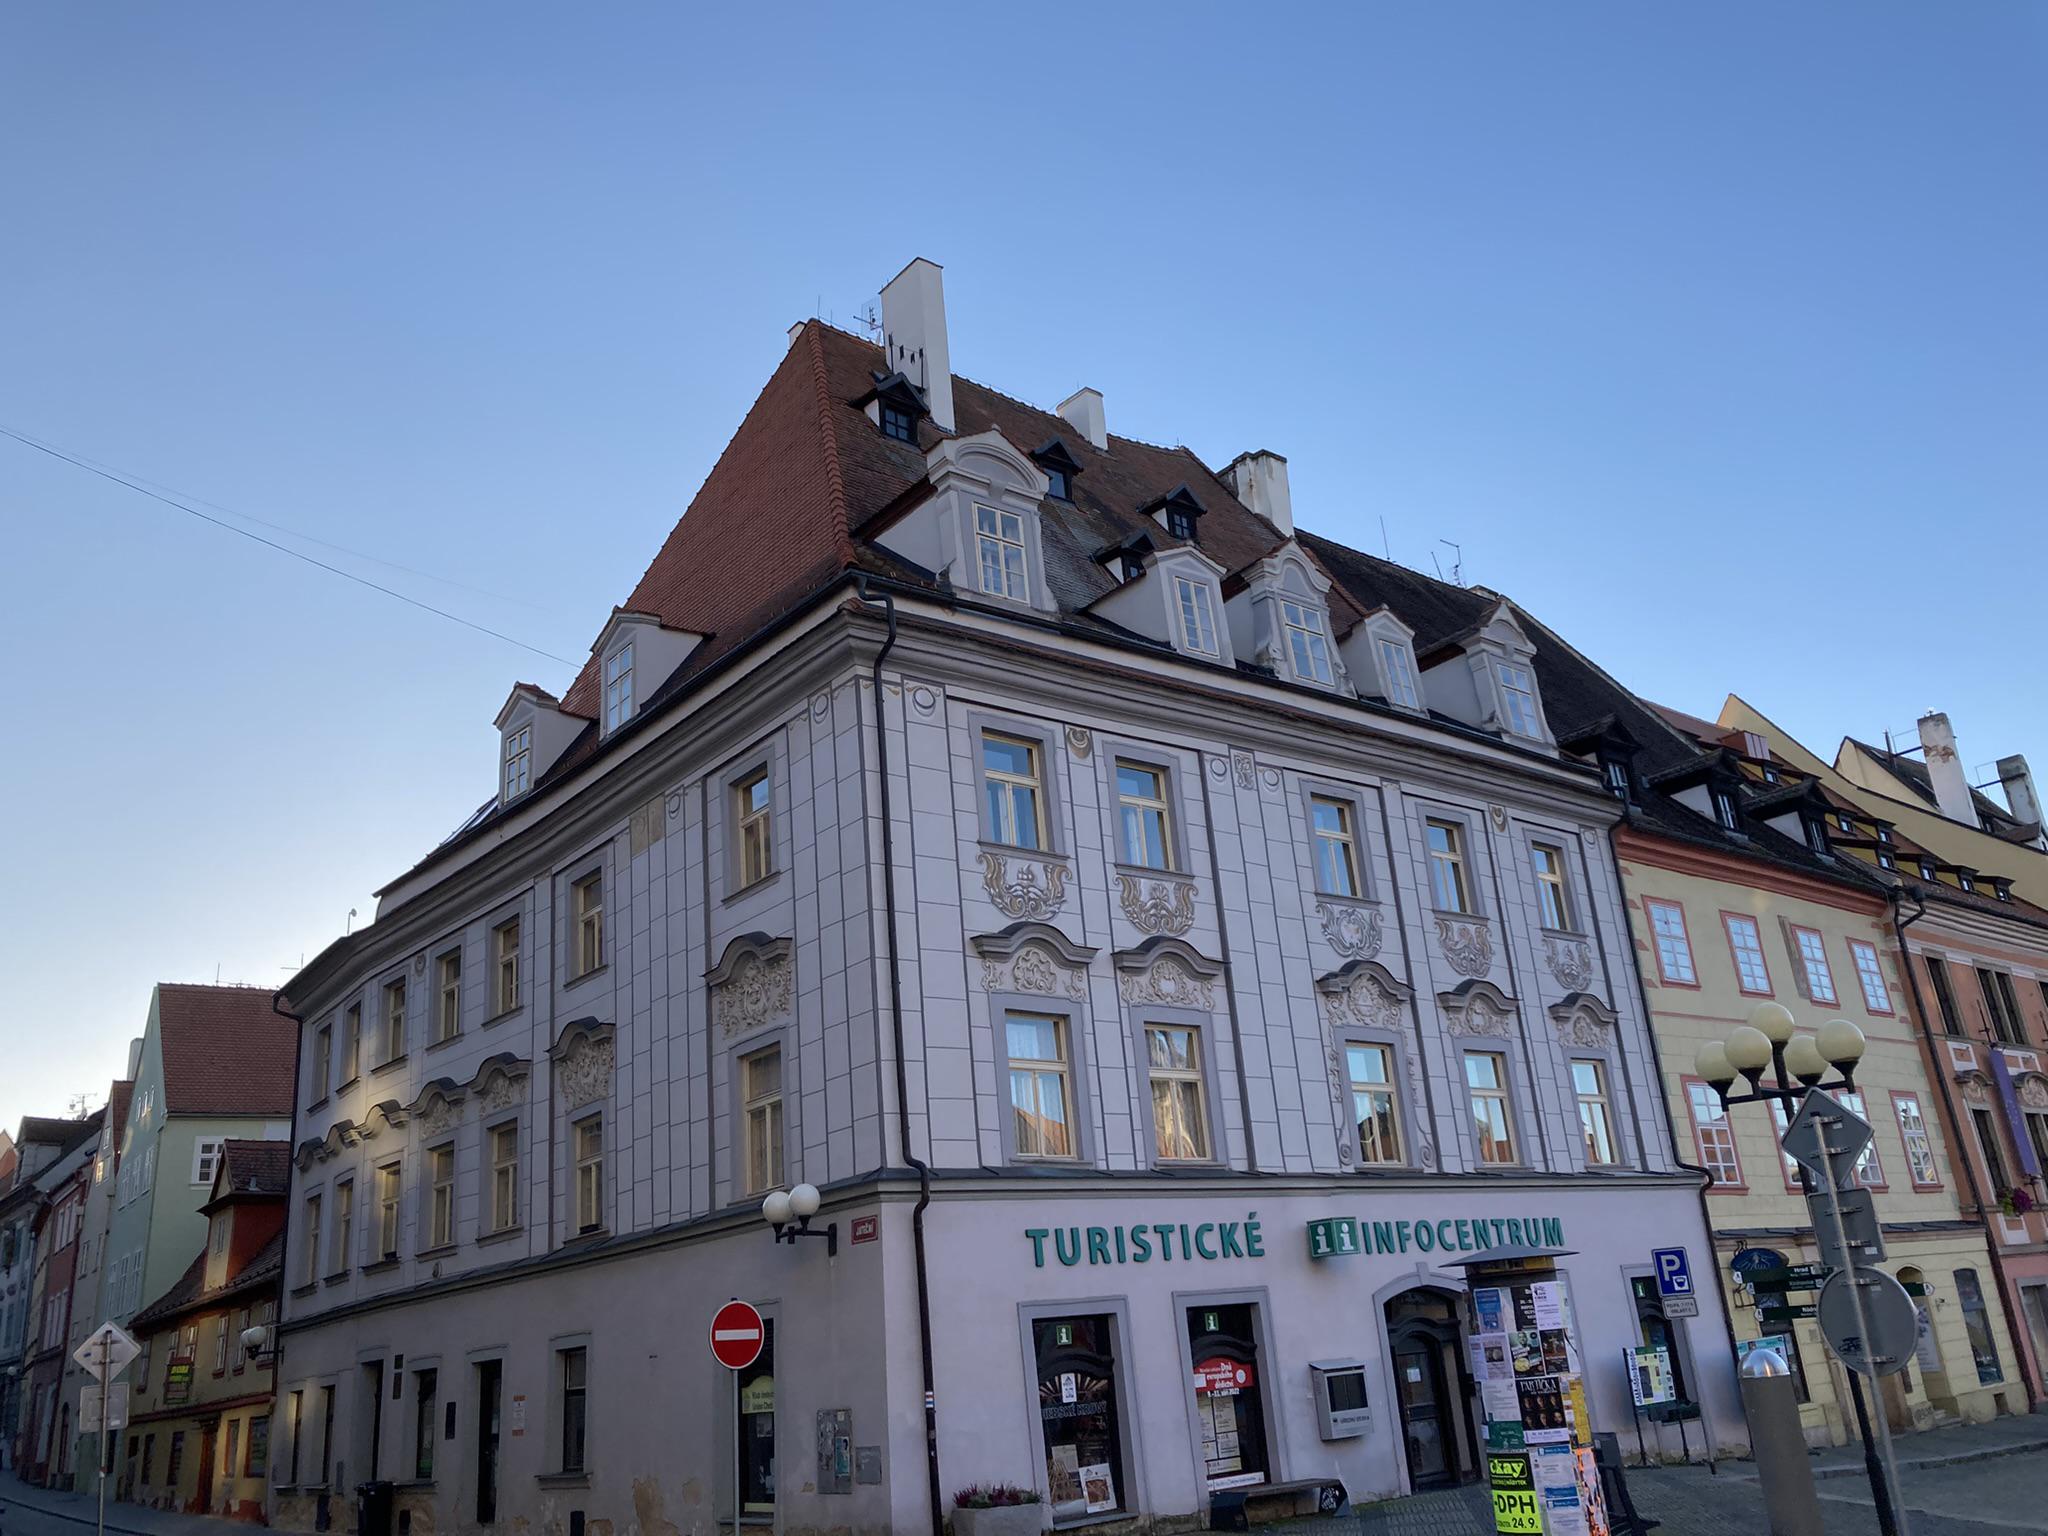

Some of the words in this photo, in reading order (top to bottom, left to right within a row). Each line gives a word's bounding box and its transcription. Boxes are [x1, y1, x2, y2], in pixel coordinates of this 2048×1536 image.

[1025, 1211, 1265, 1268] TURISTICKÉ
[1361, 1217, 1566, 1255] INFOCENTRUM
[1660, 1254, 1681, 1282] P
[1511, 1517, 1527, 1529] 24.
[1527, 1517, 1539, 1529] 9.
